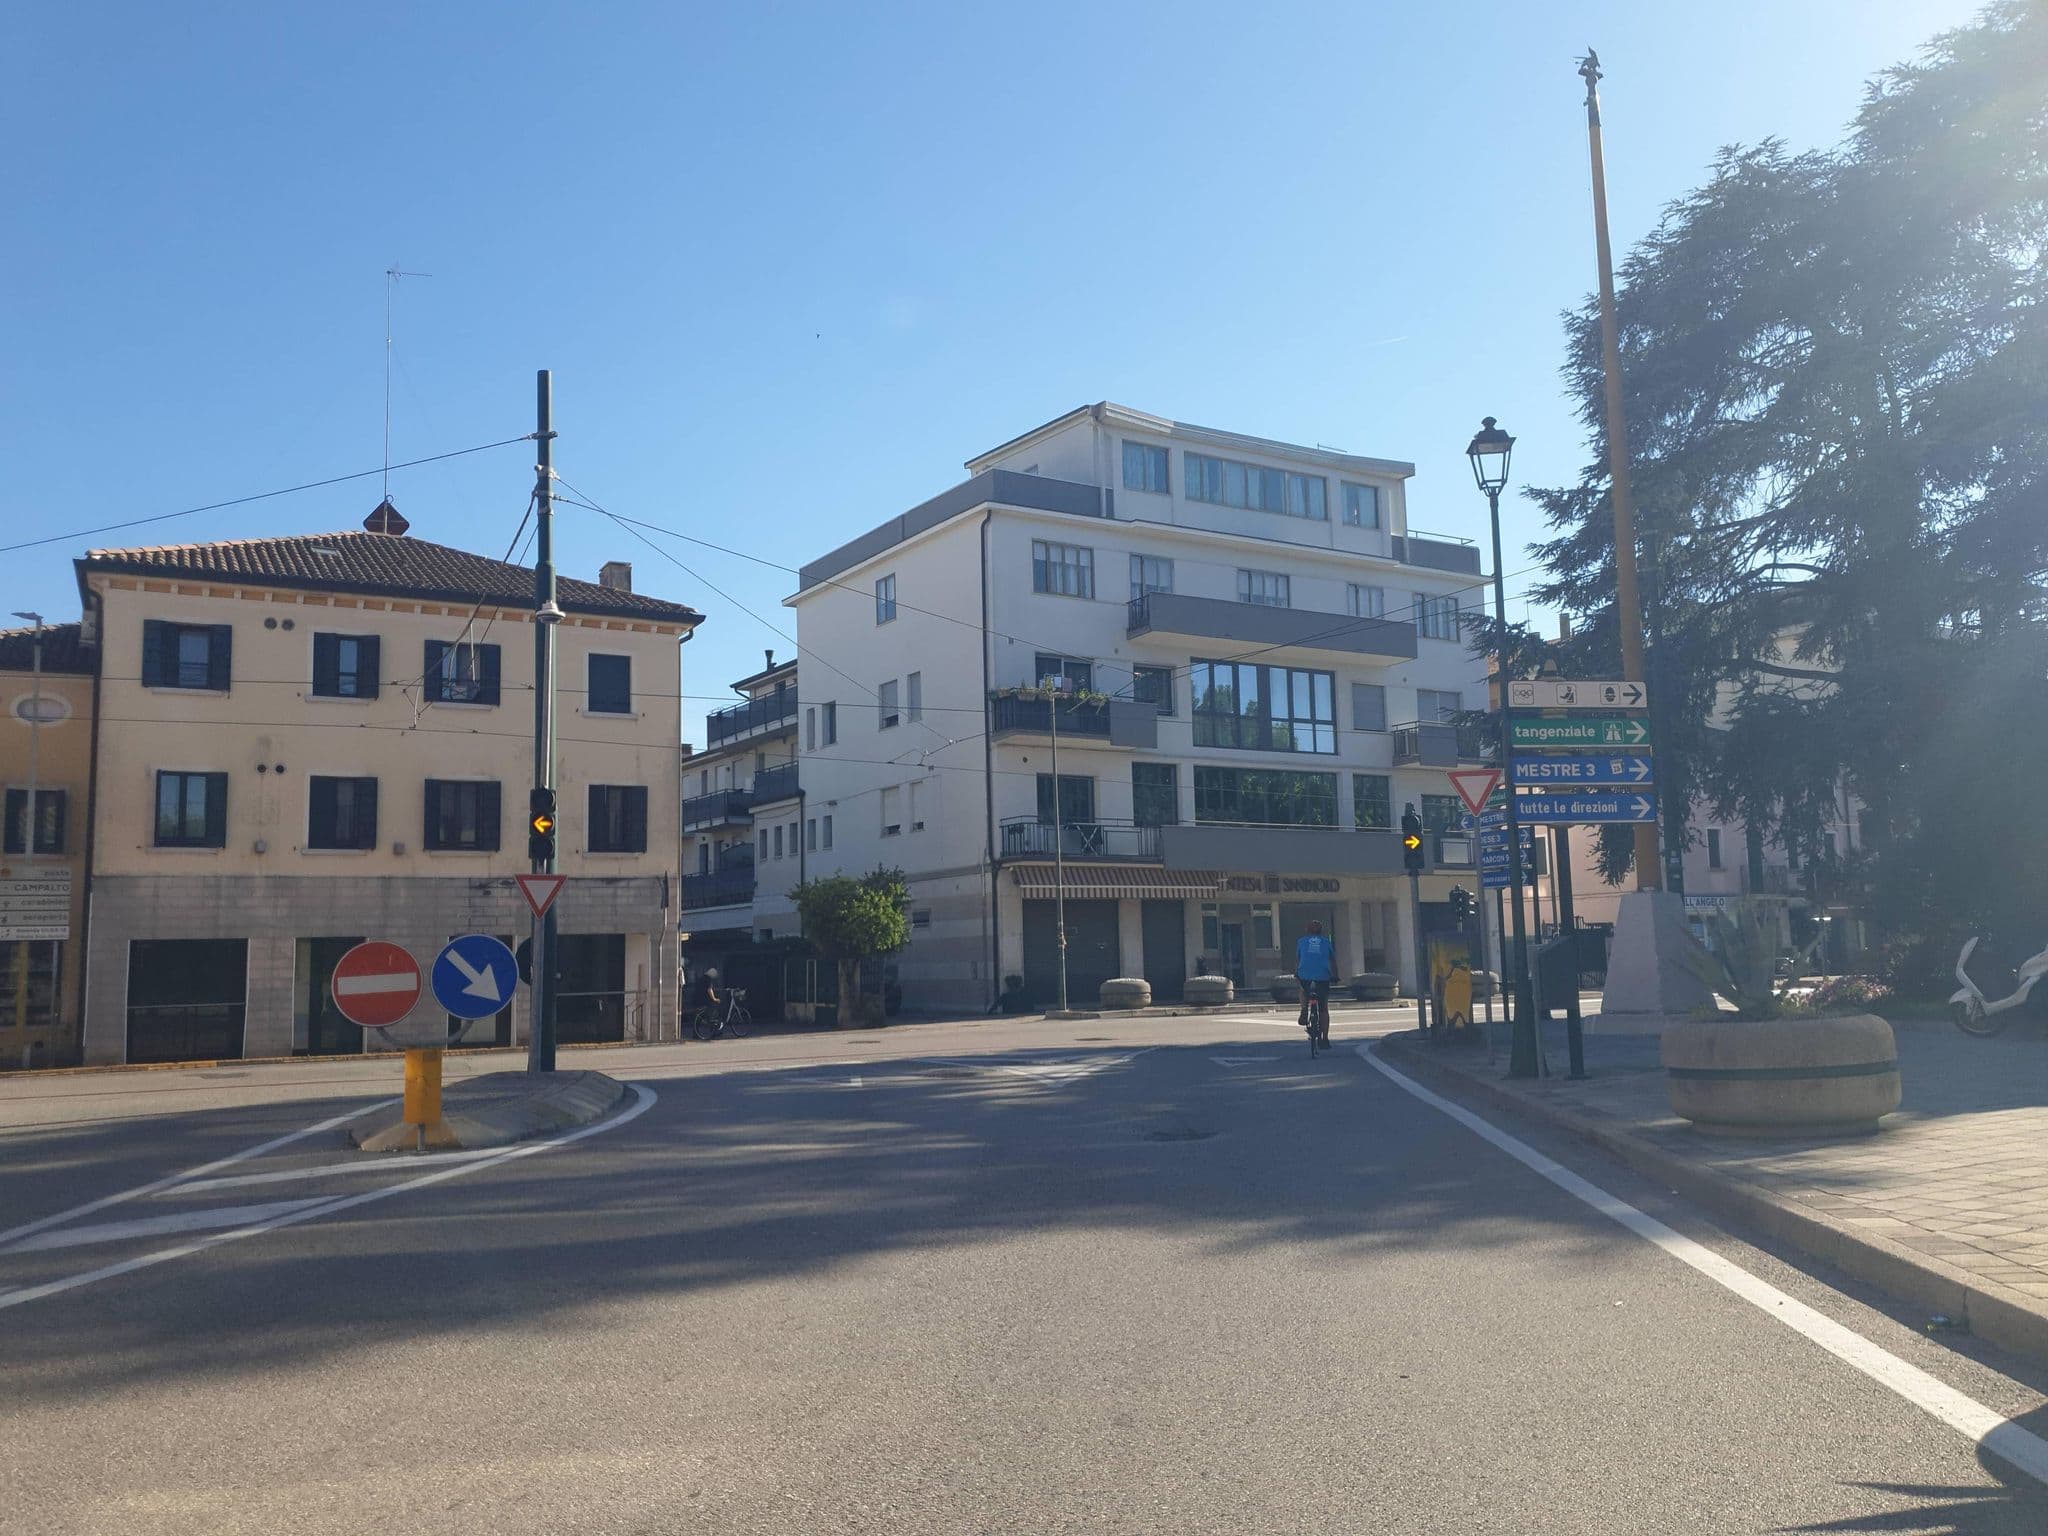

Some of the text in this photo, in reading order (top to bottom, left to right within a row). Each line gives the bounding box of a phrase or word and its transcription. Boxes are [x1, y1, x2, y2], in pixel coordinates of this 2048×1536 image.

[1515, 726, 1596, 740] tangenziale
[1516, 764, 1581, 777] MESTRE
[1586, 764, 1596, 777] 3
[1520, 800, 1618, 814] tutte le direzioni
[14, 884, 70, 892] CAMPALTO
